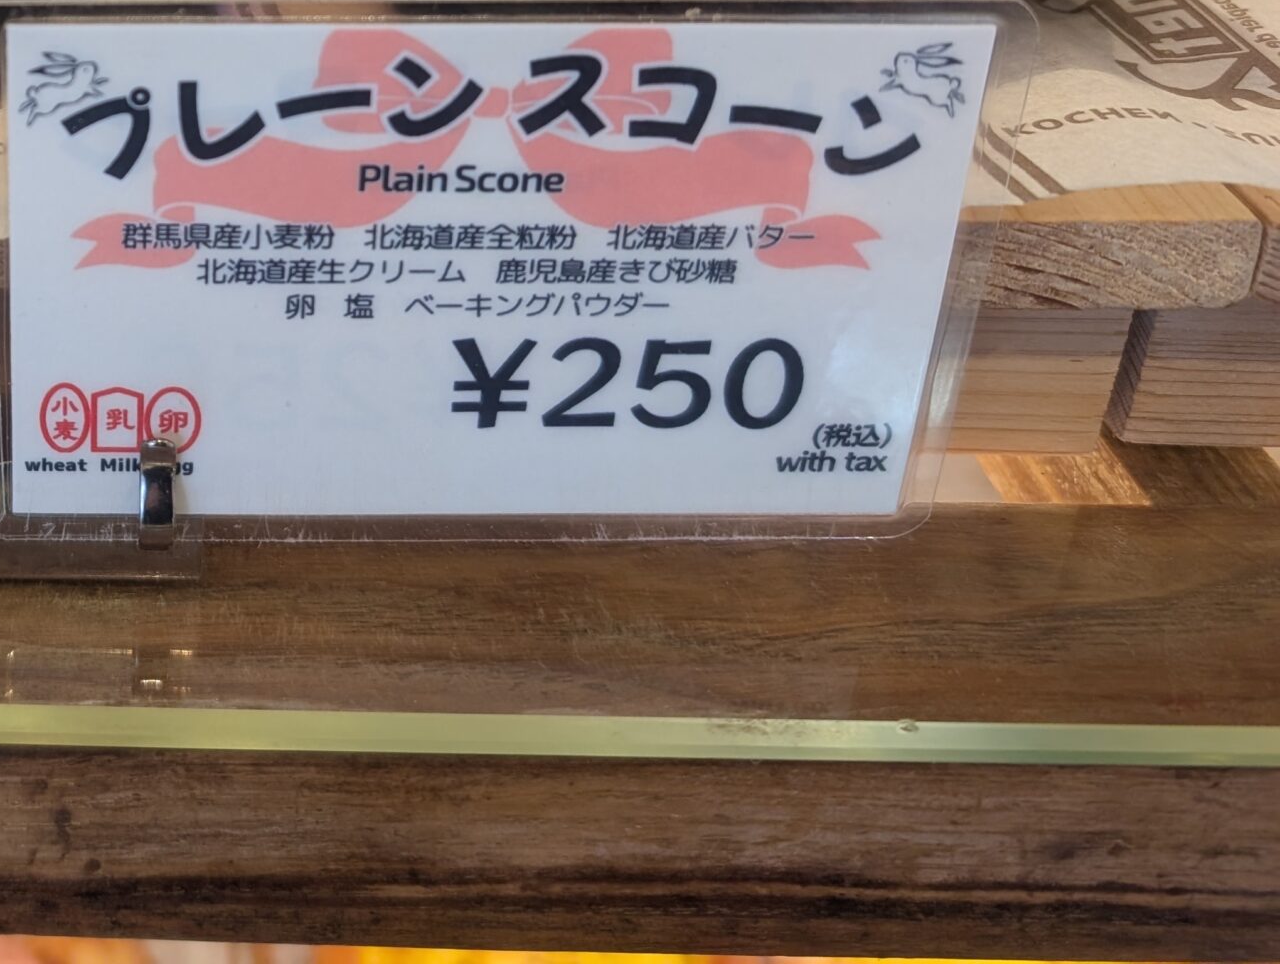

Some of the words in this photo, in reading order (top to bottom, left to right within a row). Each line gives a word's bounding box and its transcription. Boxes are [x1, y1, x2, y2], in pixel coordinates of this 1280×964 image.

[61, 54, 922, 180] プレーンスコーン
[359, 165, 448, 193] Plain
[454, 164, 564, 194] Scone
[121, 222, 335, 251] 群馬県産小麦粉
[364, 223, 577, 252] 北海道産全粒粉
[607, 223, 815, 252] 北海道産バター
[197, 257, 466, 286] 北海道産生クリーム
[495, 257, 738, 285] 鹿児島産きび砂糖
[285, 293, 315, 320] 卵
[344, 293, 375, 320] 塩
[405, 291, 670, 318] ベーキングパウダー
[451, 336, 804, 430] ¥250
[51, 396, 79, 441] 小麦
[106, 408, 136, 431] 乳
[158, 409, 189, 434] 卵
[811, 422, 893, 449] (税込)
[25, 458, 87, 472] wheat
[776, 450, 837, 473] with
[844, 451, 888, 473] tax
